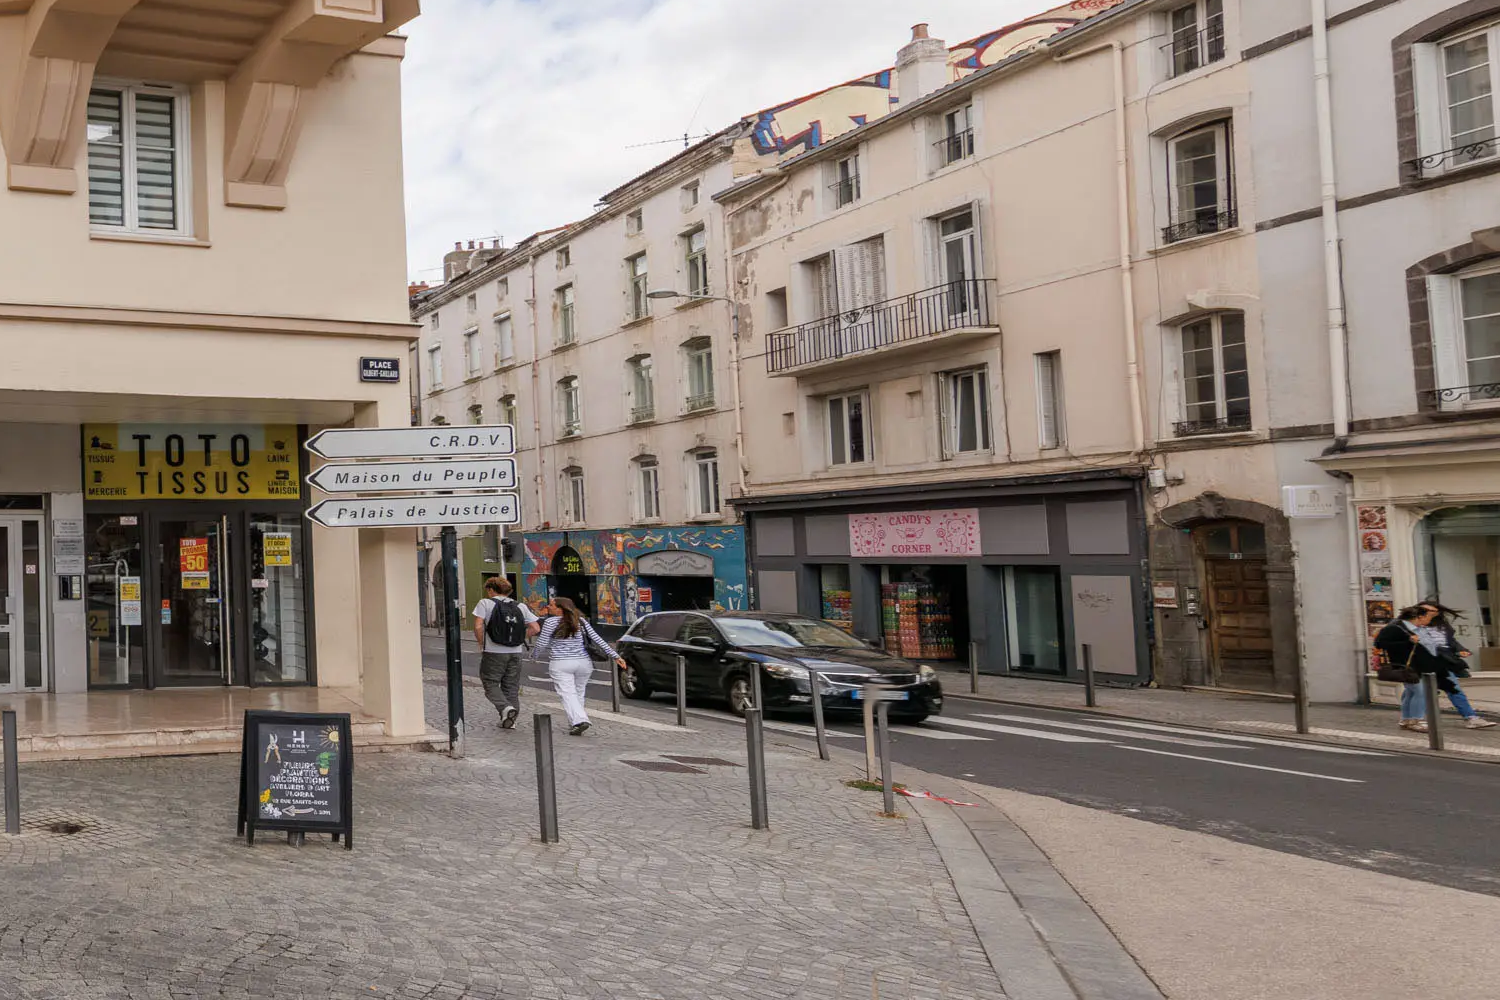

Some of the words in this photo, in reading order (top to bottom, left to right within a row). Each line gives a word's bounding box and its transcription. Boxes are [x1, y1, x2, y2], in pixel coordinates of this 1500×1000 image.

[369, 361, 392, 369] PLACE
[429, 434, 506, 448] C.R.D.V.
[131, 433, 250, 467] TOTO
[88, 455, 115, 464] TISSUS
[267, 454, 290, 463] LAINE
[334, 472, 401, 485] Maison
[412, 469, 433, 483] du
[443, 468, 507, 484] Peuple
[135, 471, 250, 495] TISSUS
[88, 487, 128, 496] MERCERIE
[267, 486, 298, 495] MAISON
[337, 506, 395, 520] Palais
[406, 504, 427, 518] de
[438, 502, 510, 517] Justice
[888, 514, 932, 526] CANDY'S
[891, 544, 932, 554] CORNER
[283, 762, 316, 770] FLEURS
[280, 768, 319, 778] PLANTES
